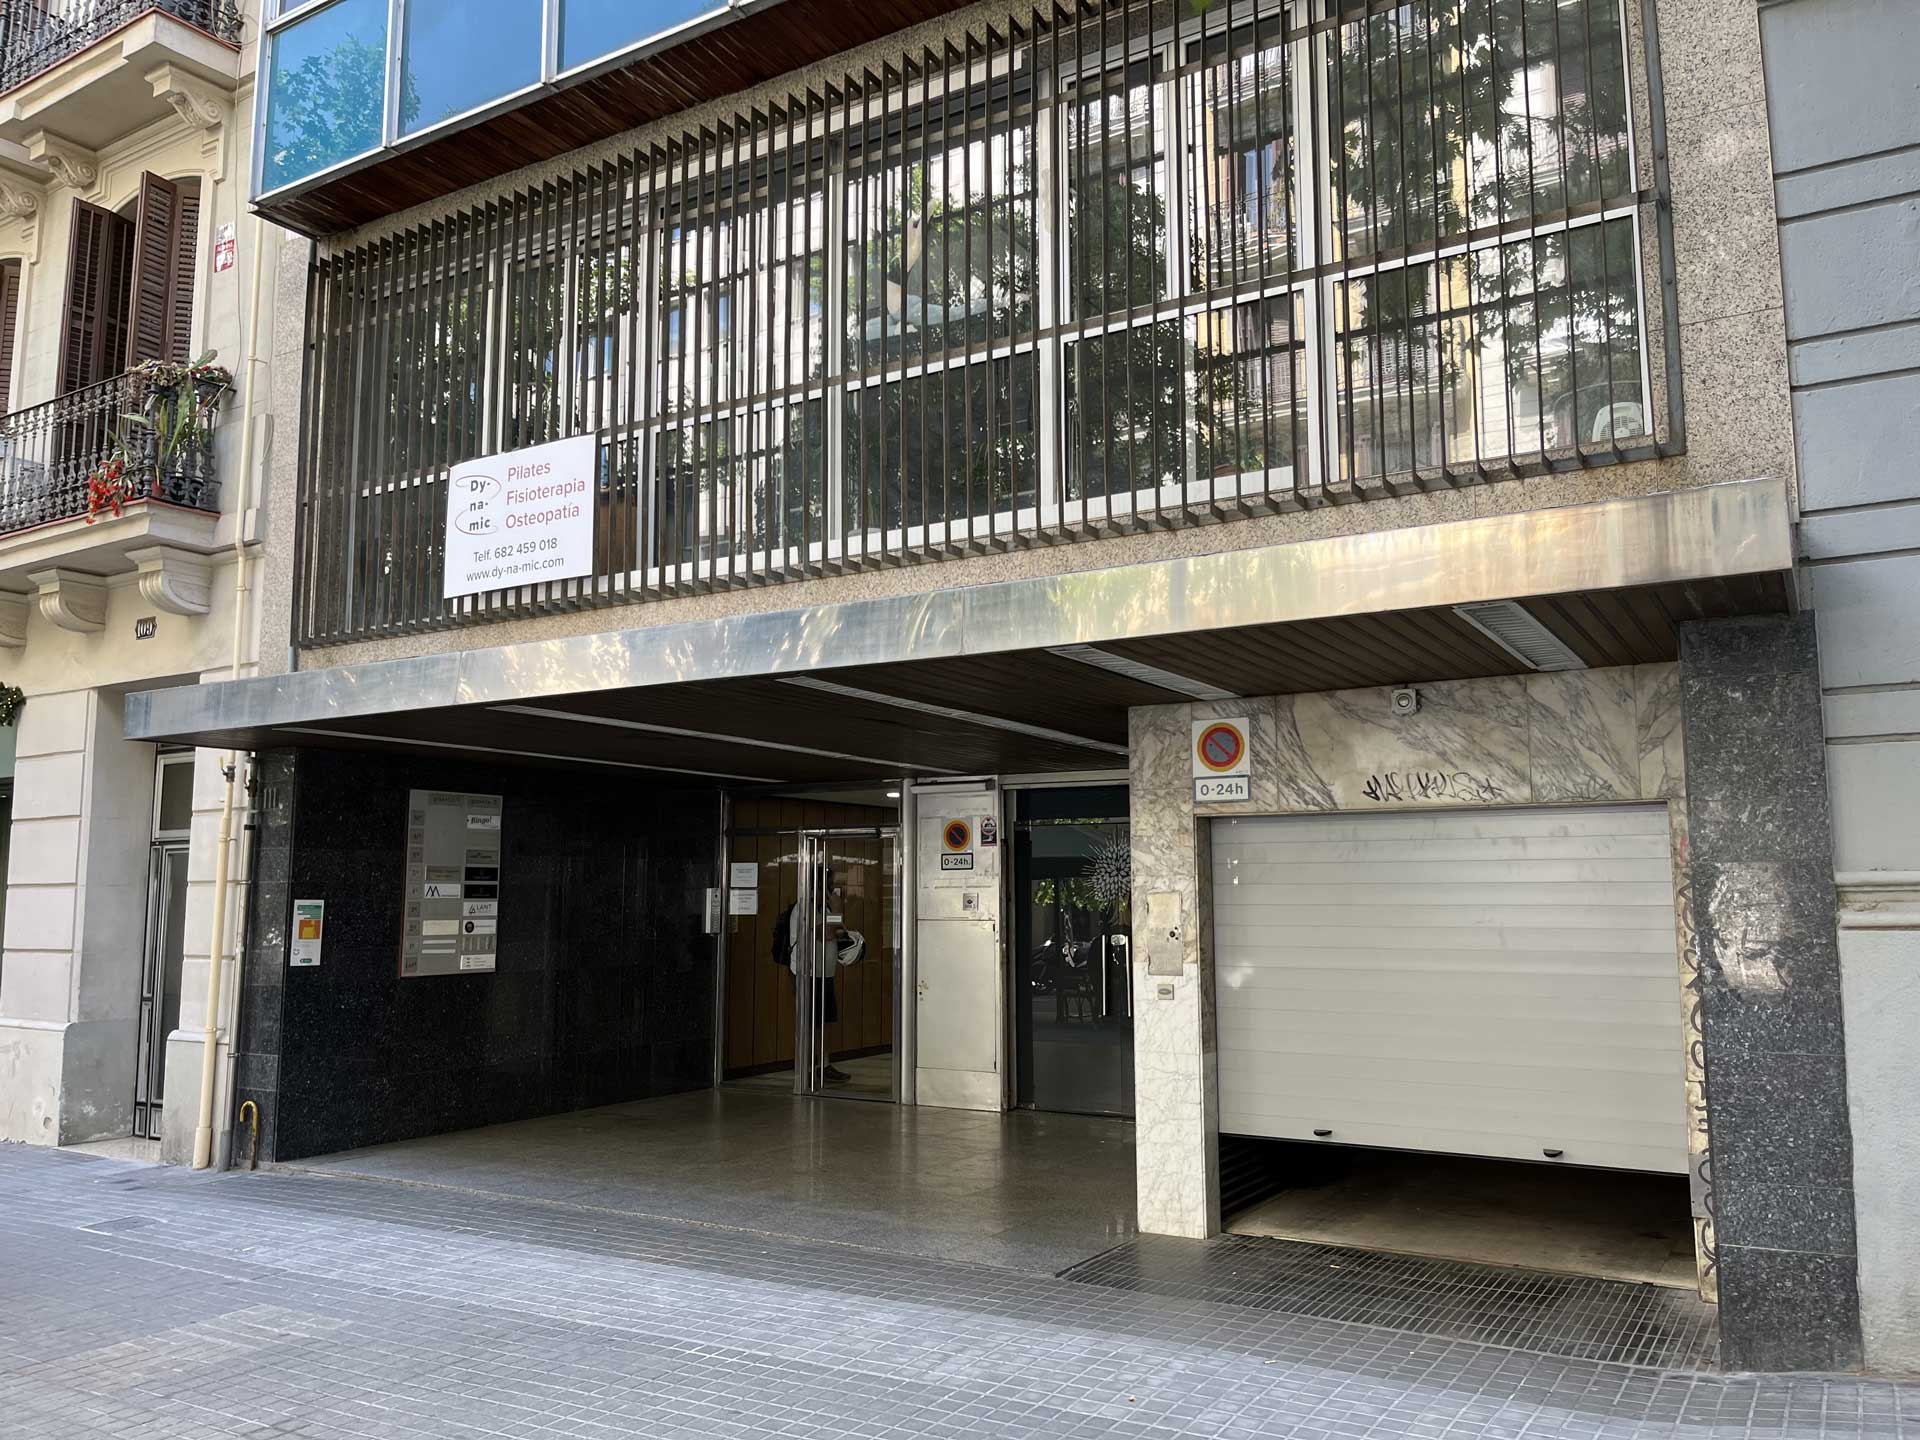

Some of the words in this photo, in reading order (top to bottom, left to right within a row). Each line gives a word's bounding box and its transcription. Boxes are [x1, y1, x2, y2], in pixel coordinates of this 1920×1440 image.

[507, 462, 551, 482] Pilates
[506, 478, 586, 506] Fisioterapia
[469, 517, 490, 532] mic
[505, 503, 580, 529] Osteopatía
[474, 550, 492, 563] Telf.
[494, 545, 514, 559] 682
[516, 541, 537, 556] 459
[539, 537, 558, 551] 018
[466, 556, 565, 582] www.dy-na-mic.com
[137, 621, 153, 637] 109
[1200, 783, 1243, 796] 0-24h
